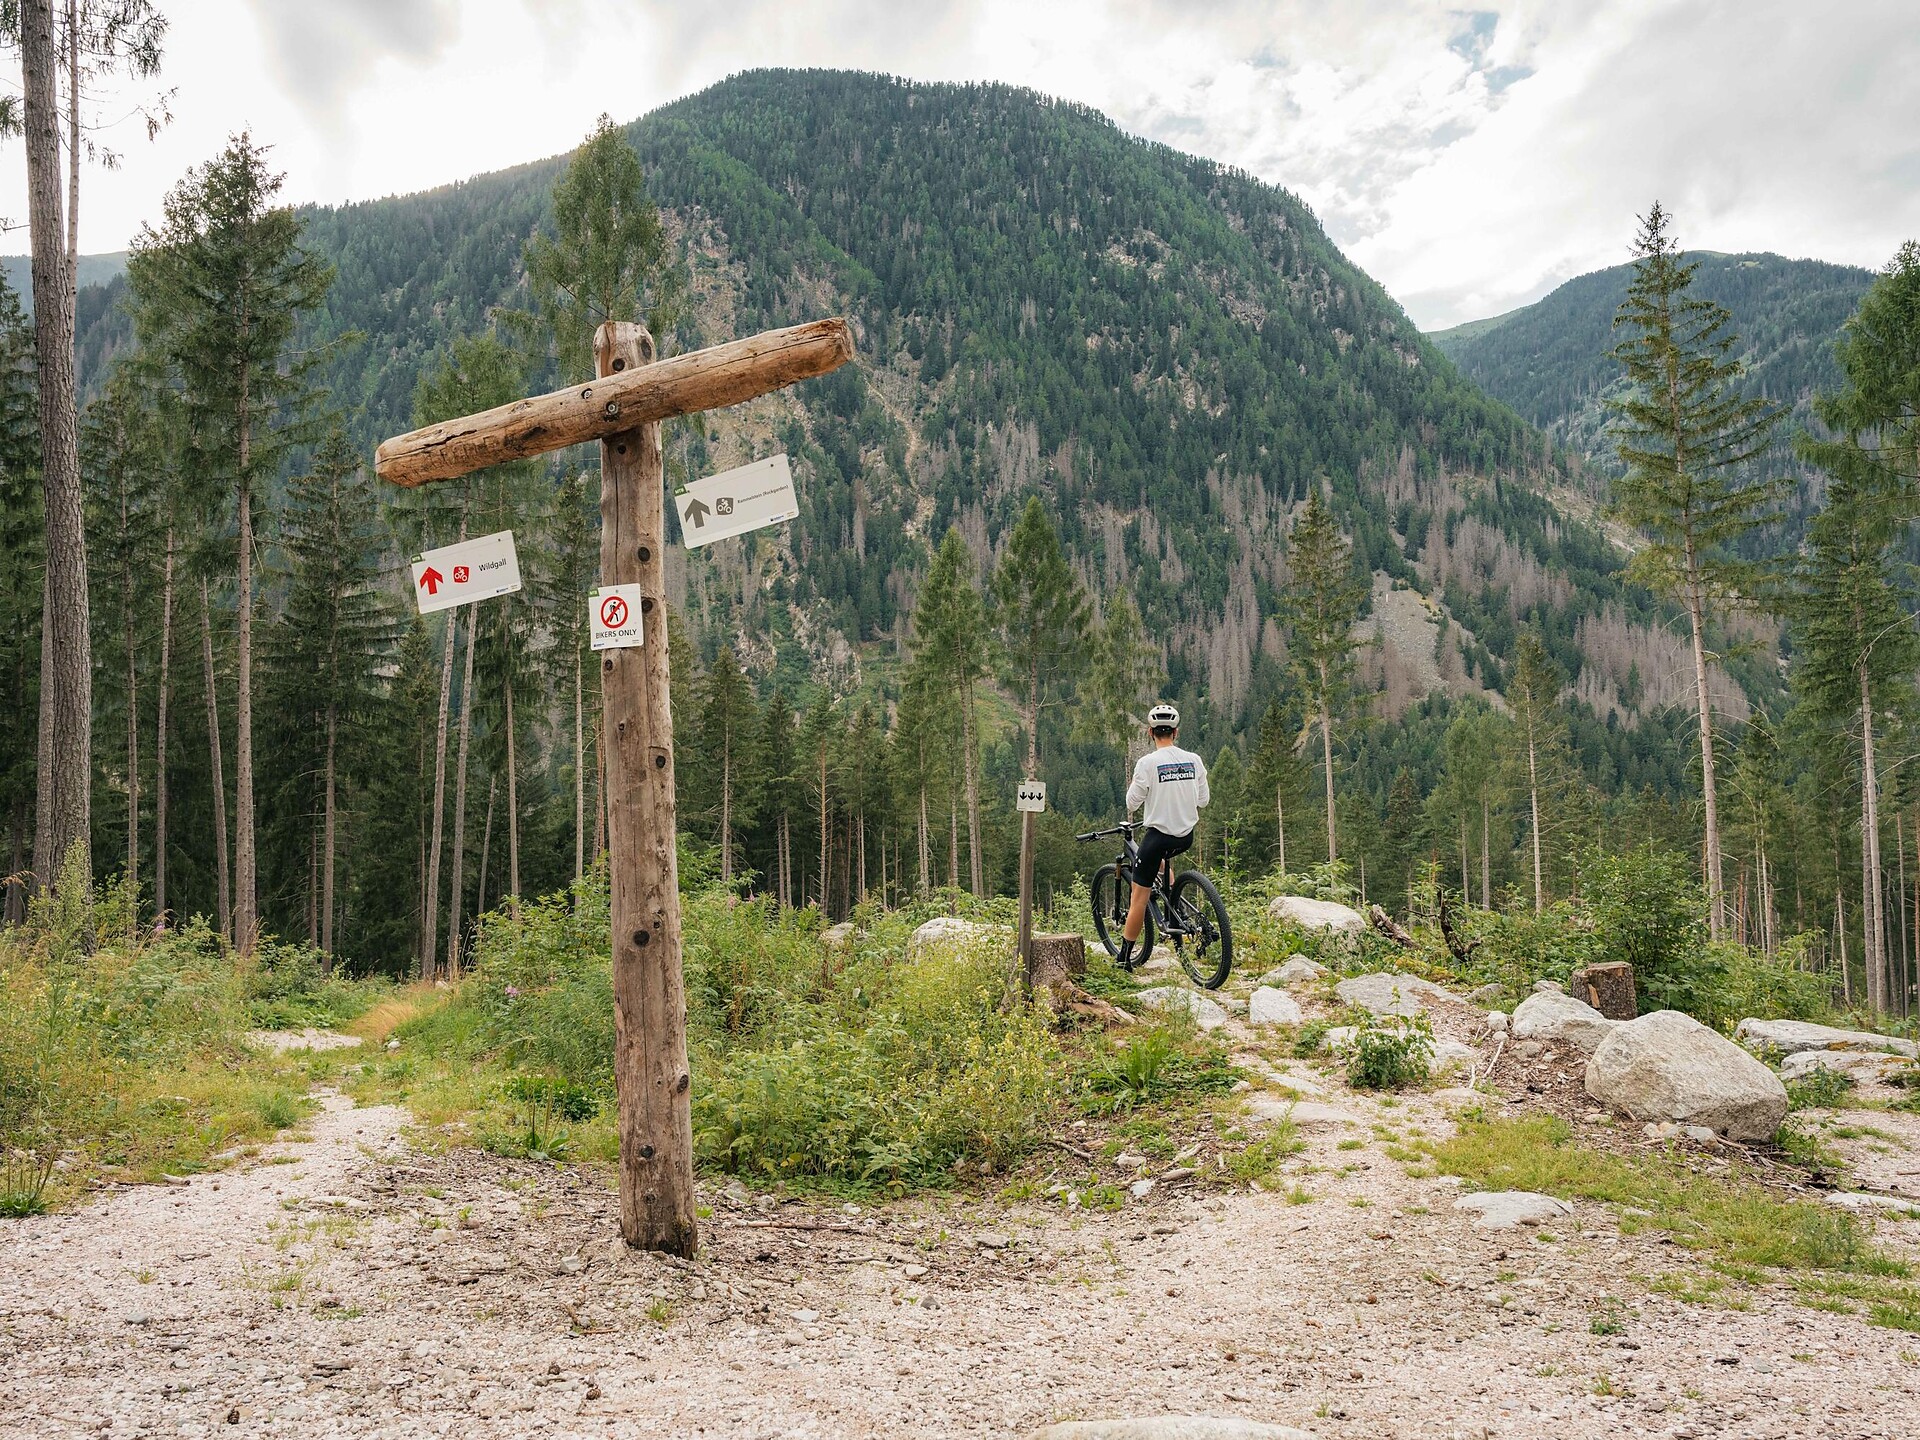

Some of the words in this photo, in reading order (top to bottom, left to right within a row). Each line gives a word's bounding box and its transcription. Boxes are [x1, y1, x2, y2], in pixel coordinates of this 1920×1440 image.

[478, 558, 507, 572] Wildgall
[595, 630, 617, 639] BIKERS
[618, 629, 637, 637] ONLY
[1160, 770, 1195, 782] patagonia
